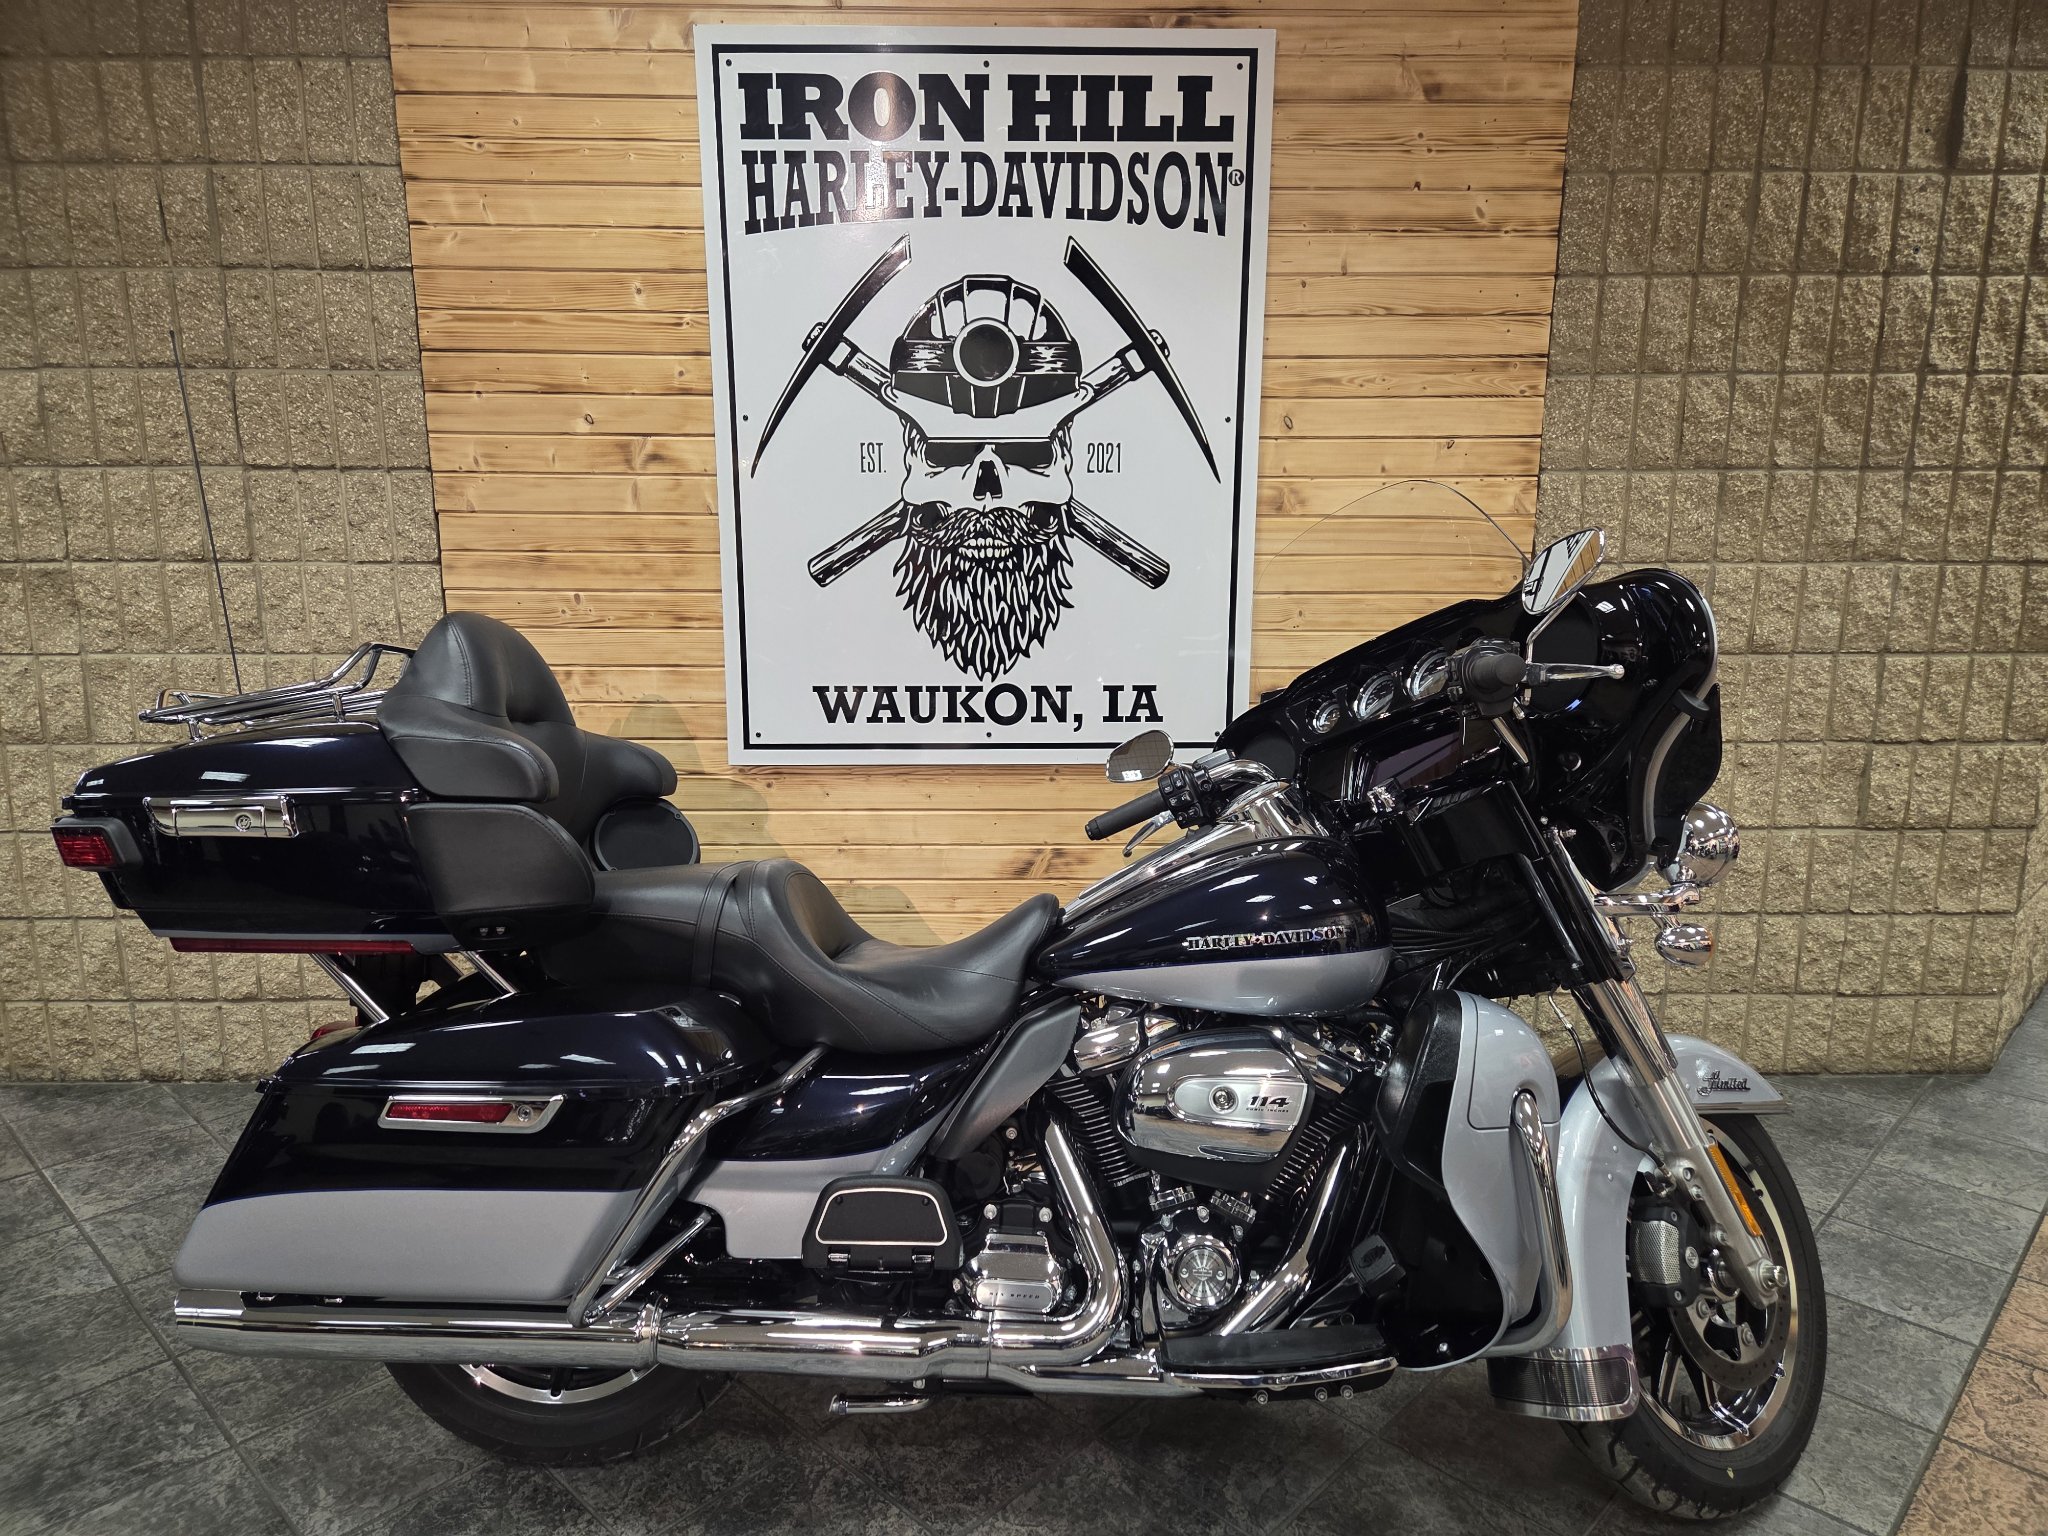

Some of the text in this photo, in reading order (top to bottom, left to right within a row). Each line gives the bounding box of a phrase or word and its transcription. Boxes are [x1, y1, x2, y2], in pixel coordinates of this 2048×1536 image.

[737, 71, 1235, 142] IRON HILL
[859, 442, 1122, 474] EST. 2021
[812, 682, 1164, 732] WAUKON, IA
[1249, 1096, 1291, 1108] 114
